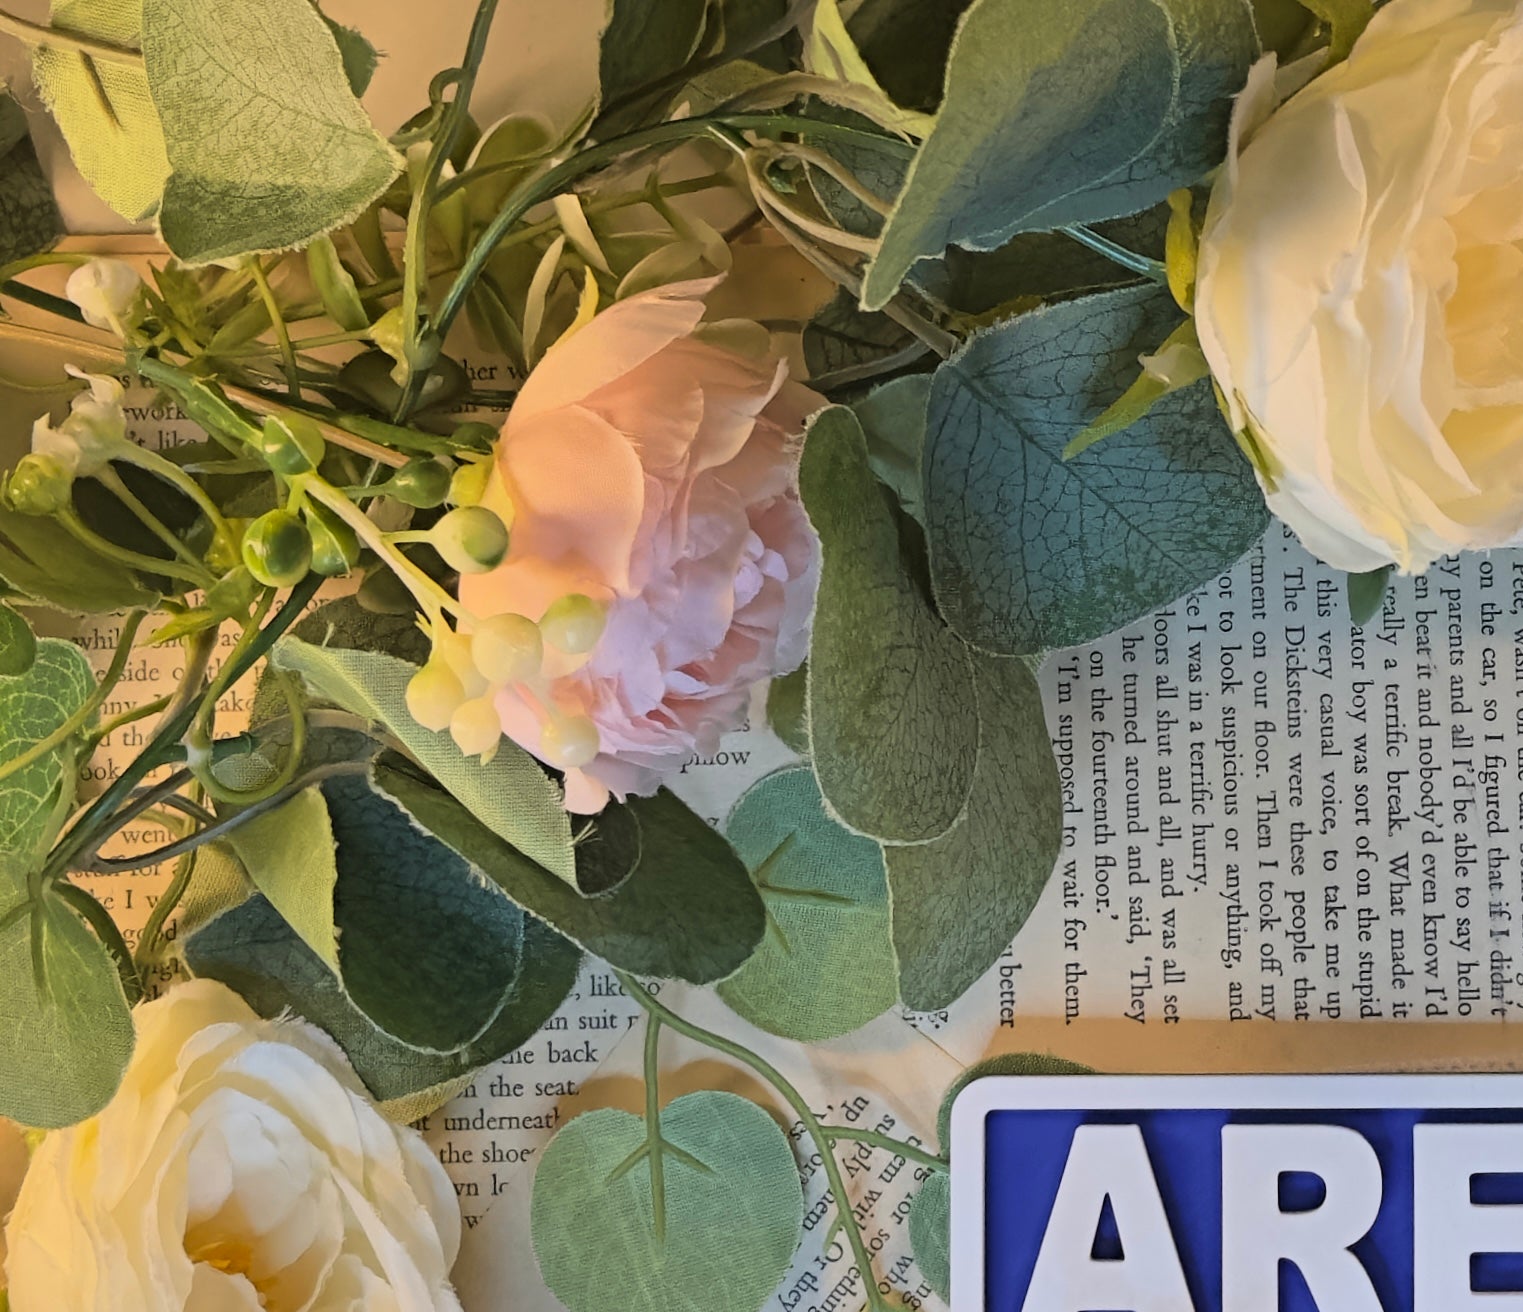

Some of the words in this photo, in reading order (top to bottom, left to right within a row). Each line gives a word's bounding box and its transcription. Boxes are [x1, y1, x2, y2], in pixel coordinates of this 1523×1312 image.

[1283, 567, 1306, 612] The
[1218, 610, 1235, 633] to
[1089, 650, 1104, 679] on
[1121, 635, 1145, 662] he
[1220, 644, 1244, 695] look
[1091, 687, 1113, 722] the
[1284, 625, 1308, 739] Dicksteins
[1123, 673, 1147, 745] turned
[1214, 706, 1244, 816] suspicious
[1288, 752, 1303, 807] were
[1091, 730, 1117, 846] fourteenth
[1125, 756, 1150, 835] around
[1224, 827, 1239, 852] or
[1290, 821, 1313, 876] these
[1127, 845, 1151, 886] and
[1125, 896, 1152, 944] said,
[1218, 863, 1250, 969] anything,
[1283, 890, 1316, 964] people
[1228, 981, 1253, 1023] and
[1293, 977, 1317, 1022] that
[547, 1040, 599, 1064] back
[489, 1074, 524, 1098] the
